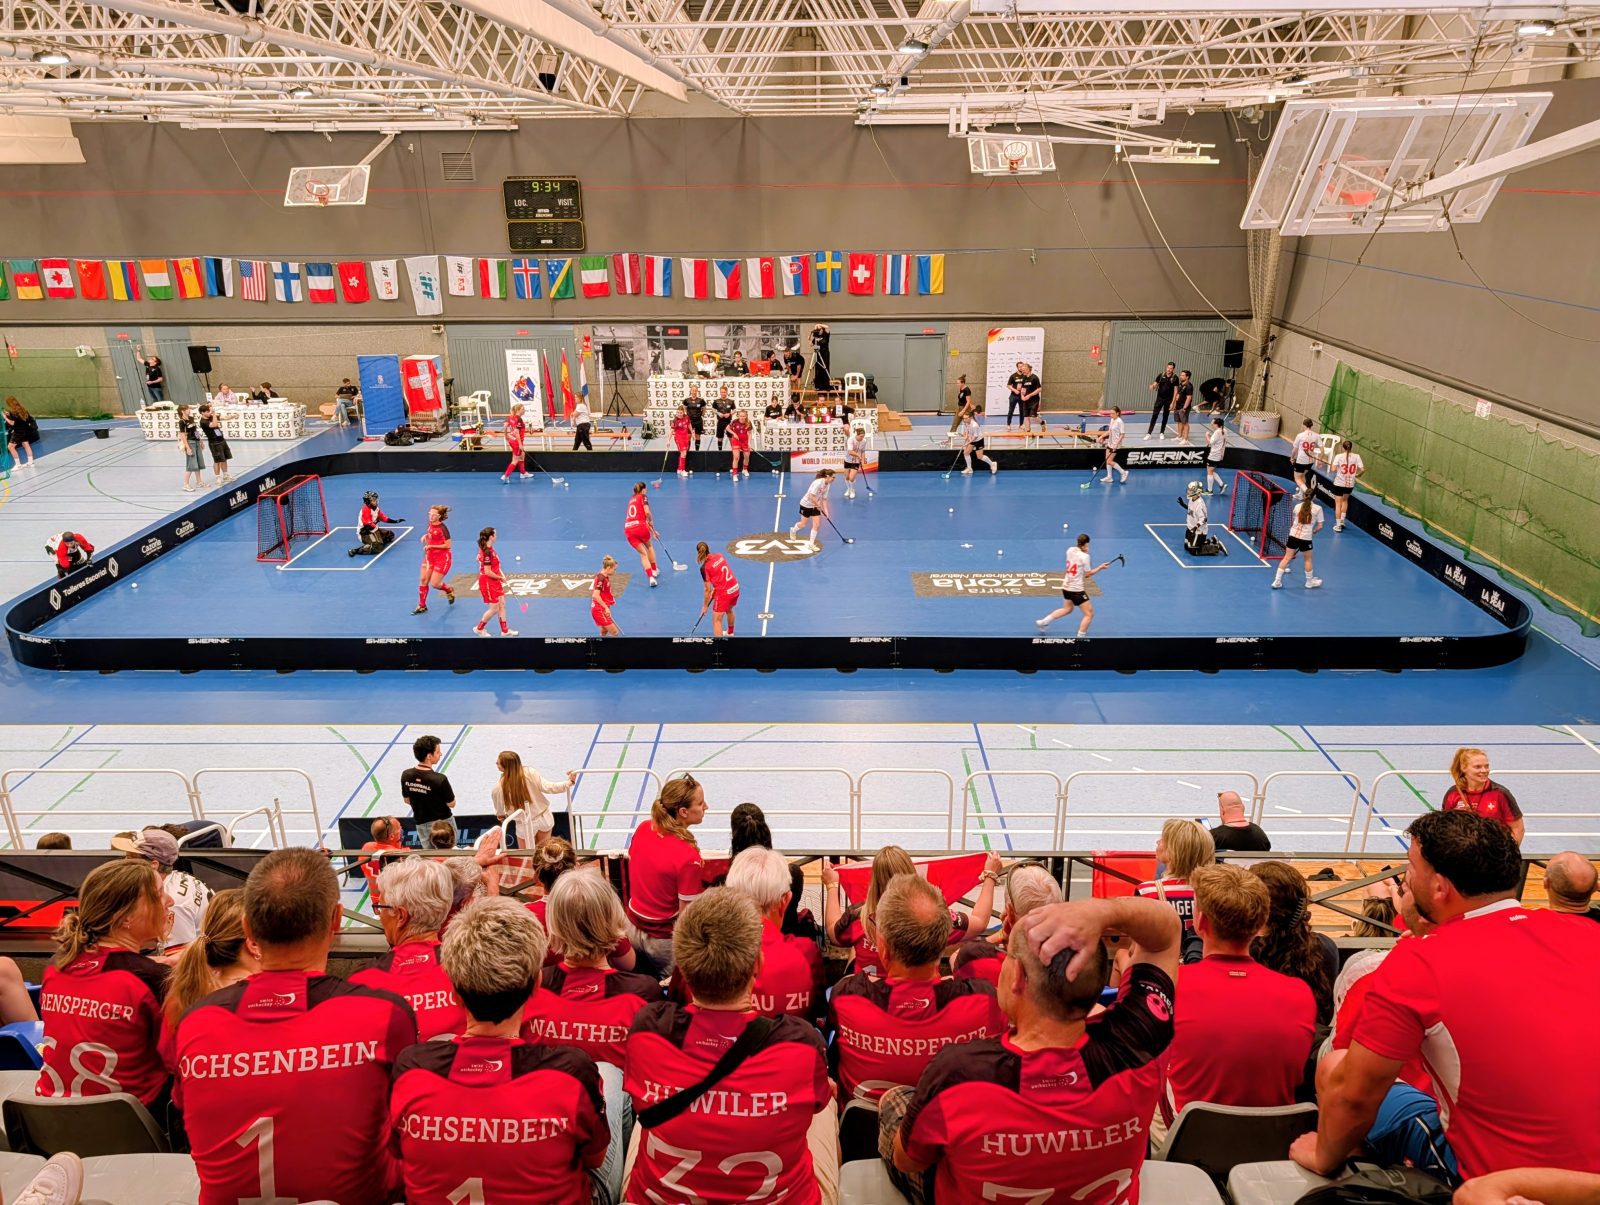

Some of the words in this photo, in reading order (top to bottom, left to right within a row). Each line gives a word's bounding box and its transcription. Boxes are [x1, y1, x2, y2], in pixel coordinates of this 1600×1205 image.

[532, 182, 560, 192] 9:34
[1127, 451, 1204, 461] SWERINK
[1341, 464, 1357, 474] 30
[932, 578, 1063, 590] Cazorla
[752, 994, 774, 1011] AU
[786, 992, 809, 1010] ZH
[180, 1041, 378, 1079] OCHSENBEIN
[981, 1116, 1142, 1156] HUWILER
[235, 1116, 298, 1205] 1
